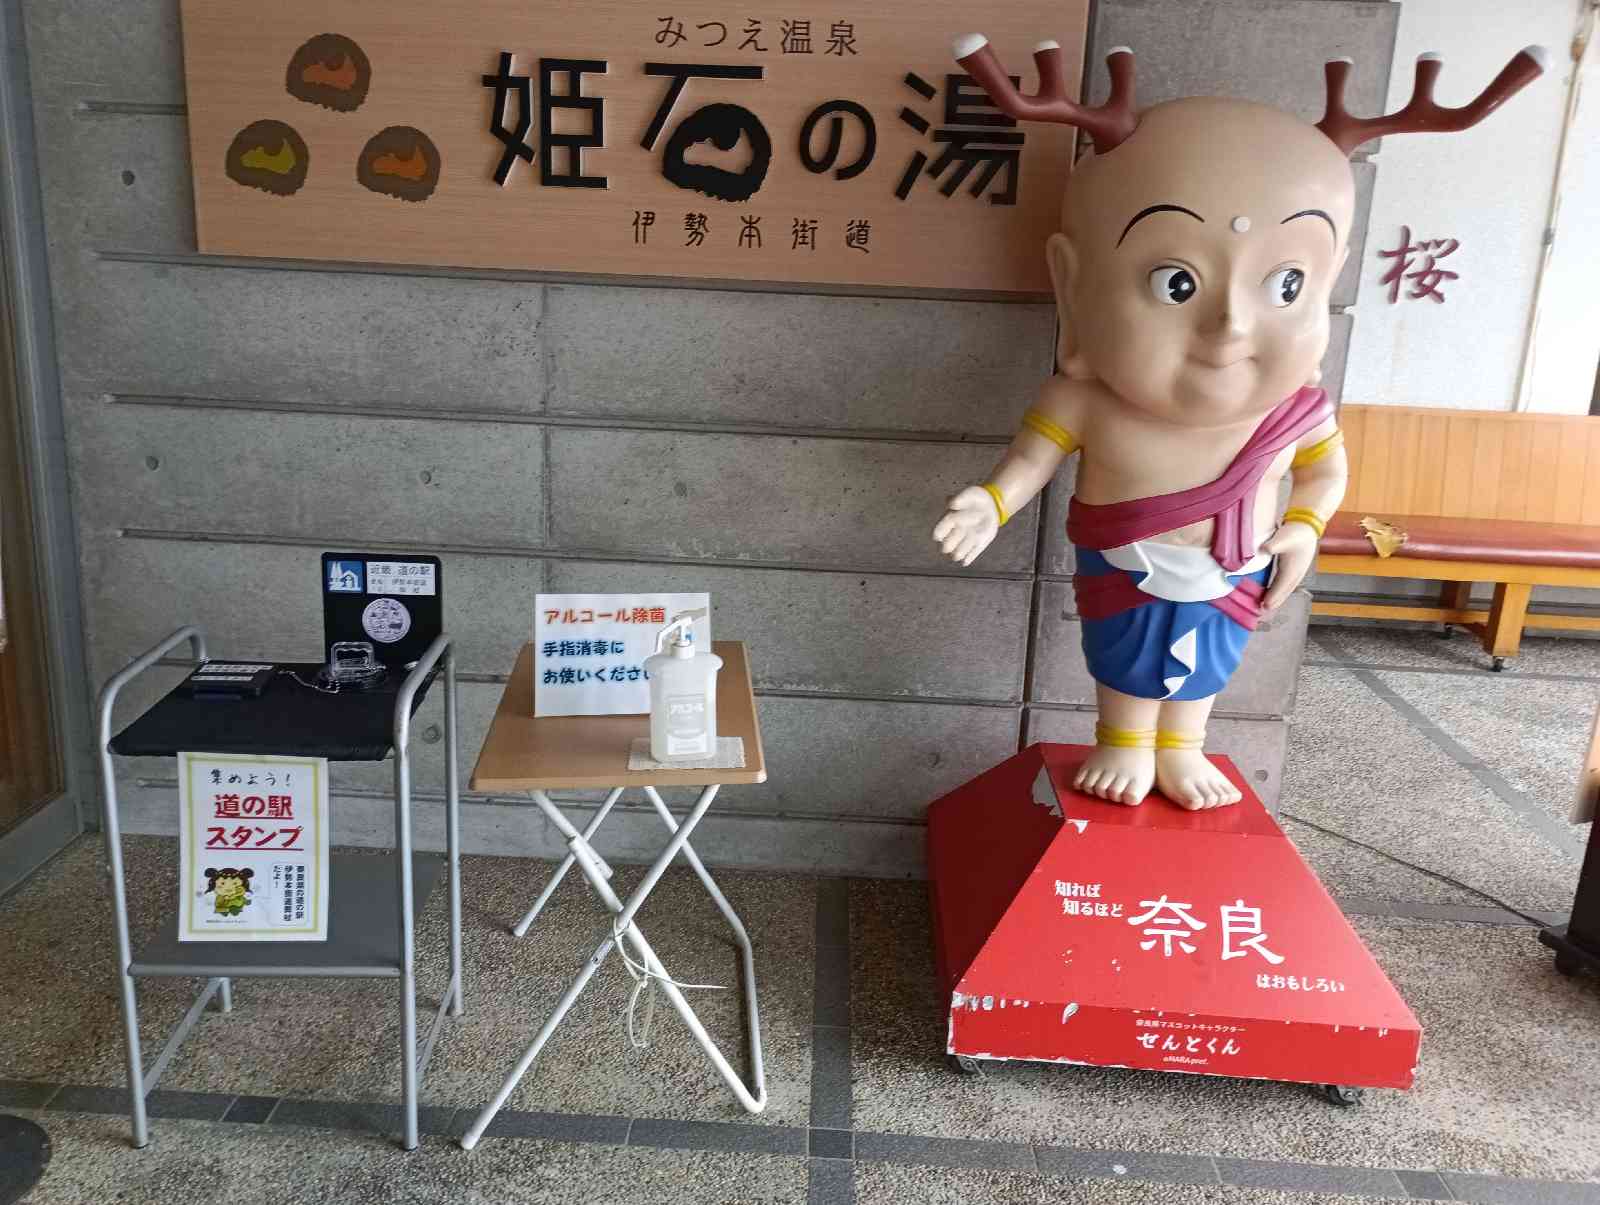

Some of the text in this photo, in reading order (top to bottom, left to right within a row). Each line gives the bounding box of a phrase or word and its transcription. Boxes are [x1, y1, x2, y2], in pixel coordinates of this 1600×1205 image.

[655, 16, 858, 56] みつえ温泉
[482, 51, 1026, 207] 姫石の湯
[632, 210, 872, 253] 伊勢本街道
[1376, 225, 1459, 304] 桜
[543, 607, 666, 625] アルコール除菌
[543, 640, 625, 658] 手指消毒に
[214, 793, 293, 817] 道の駅
[206, 825, 305, 848] スタンプ
[1054, 879, 1102, 898] 知れば
[1062, 898, 1124, 918] 知るほど
[1127, 894, 1286, 965] 奈良
[1255, 973, 1346, 994] はおもしろい
[1135, 1032, 1241, 1056] せんとくん
